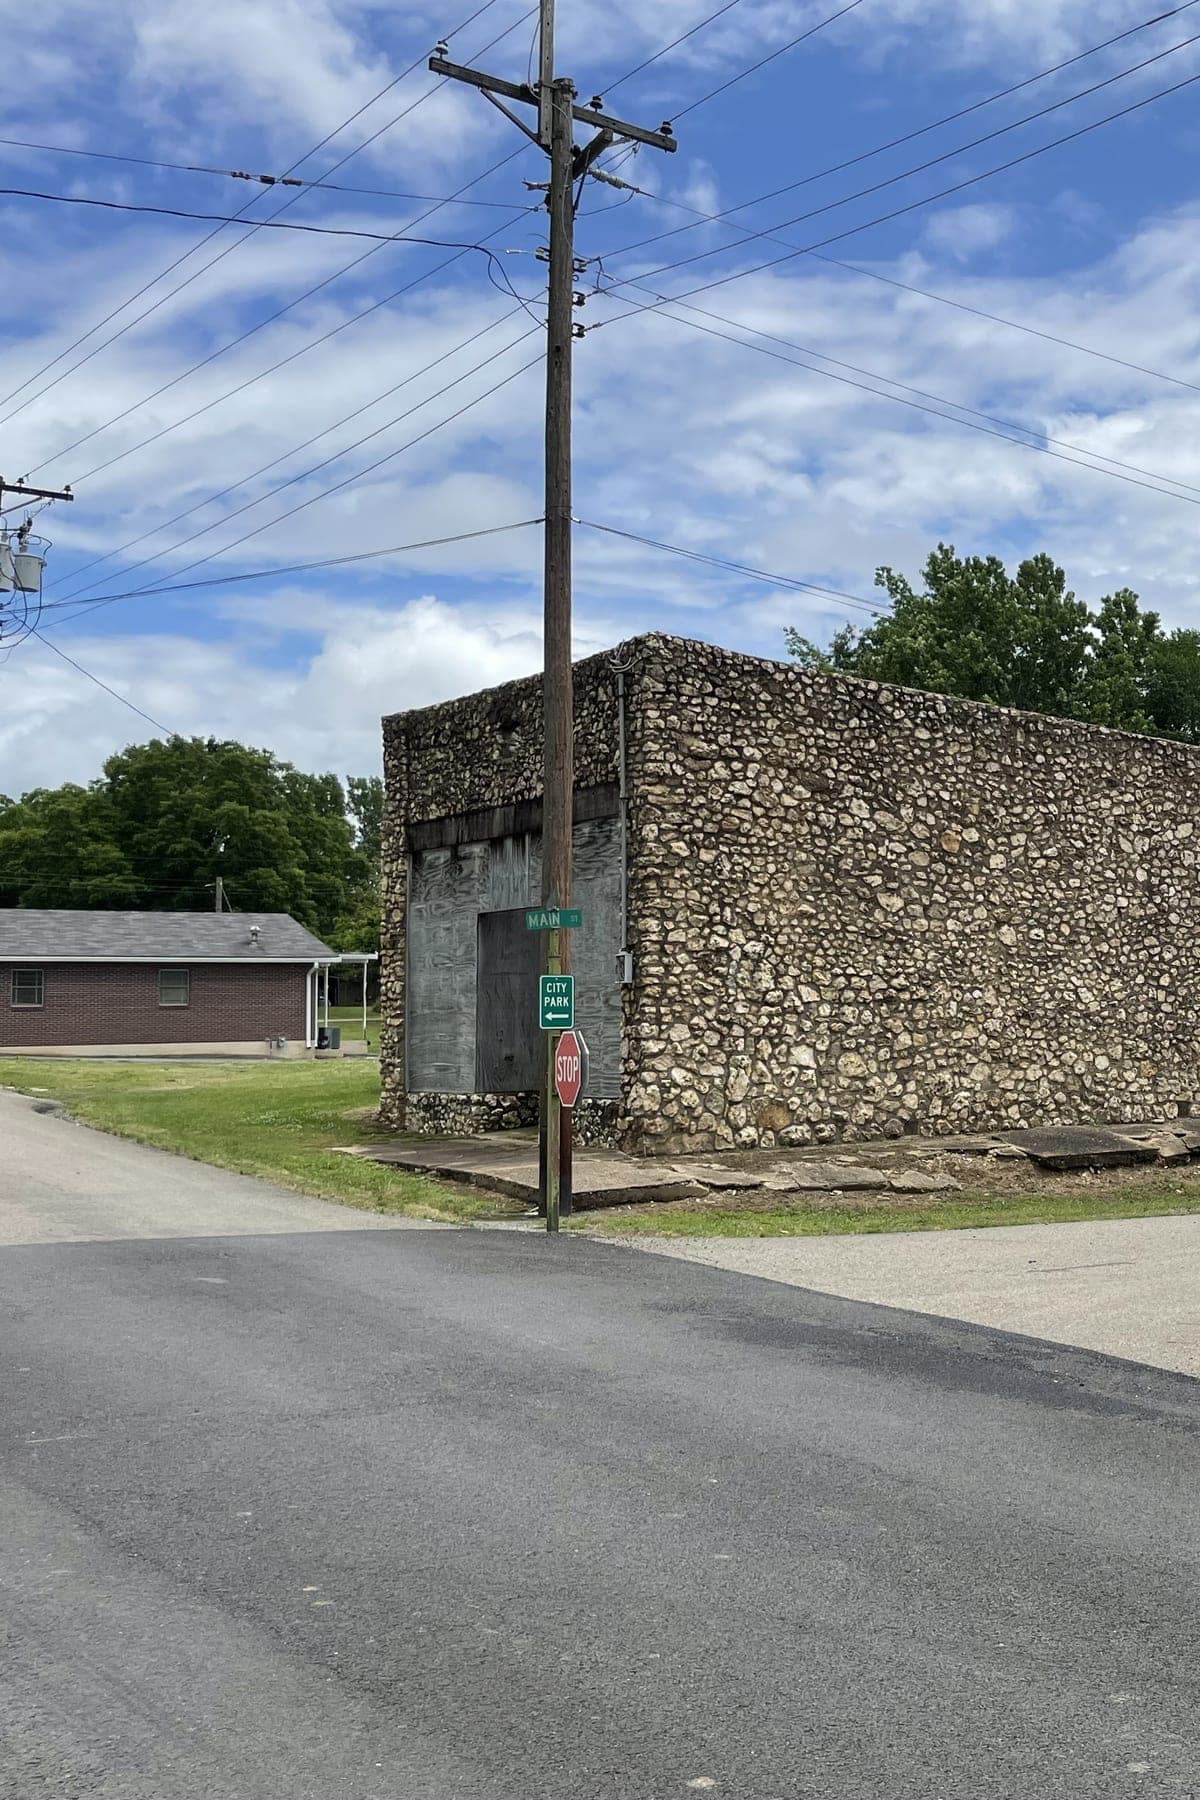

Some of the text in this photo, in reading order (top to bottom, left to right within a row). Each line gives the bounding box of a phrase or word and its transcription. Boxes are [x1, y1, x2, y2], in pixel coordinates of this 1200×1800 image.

[528, 911, 578, 928] MAIN ST
[546, 982, 567, 993] CITY
[544, 996, 569, 1007] PARK
[557, 1055, 579, 1083] STOP
